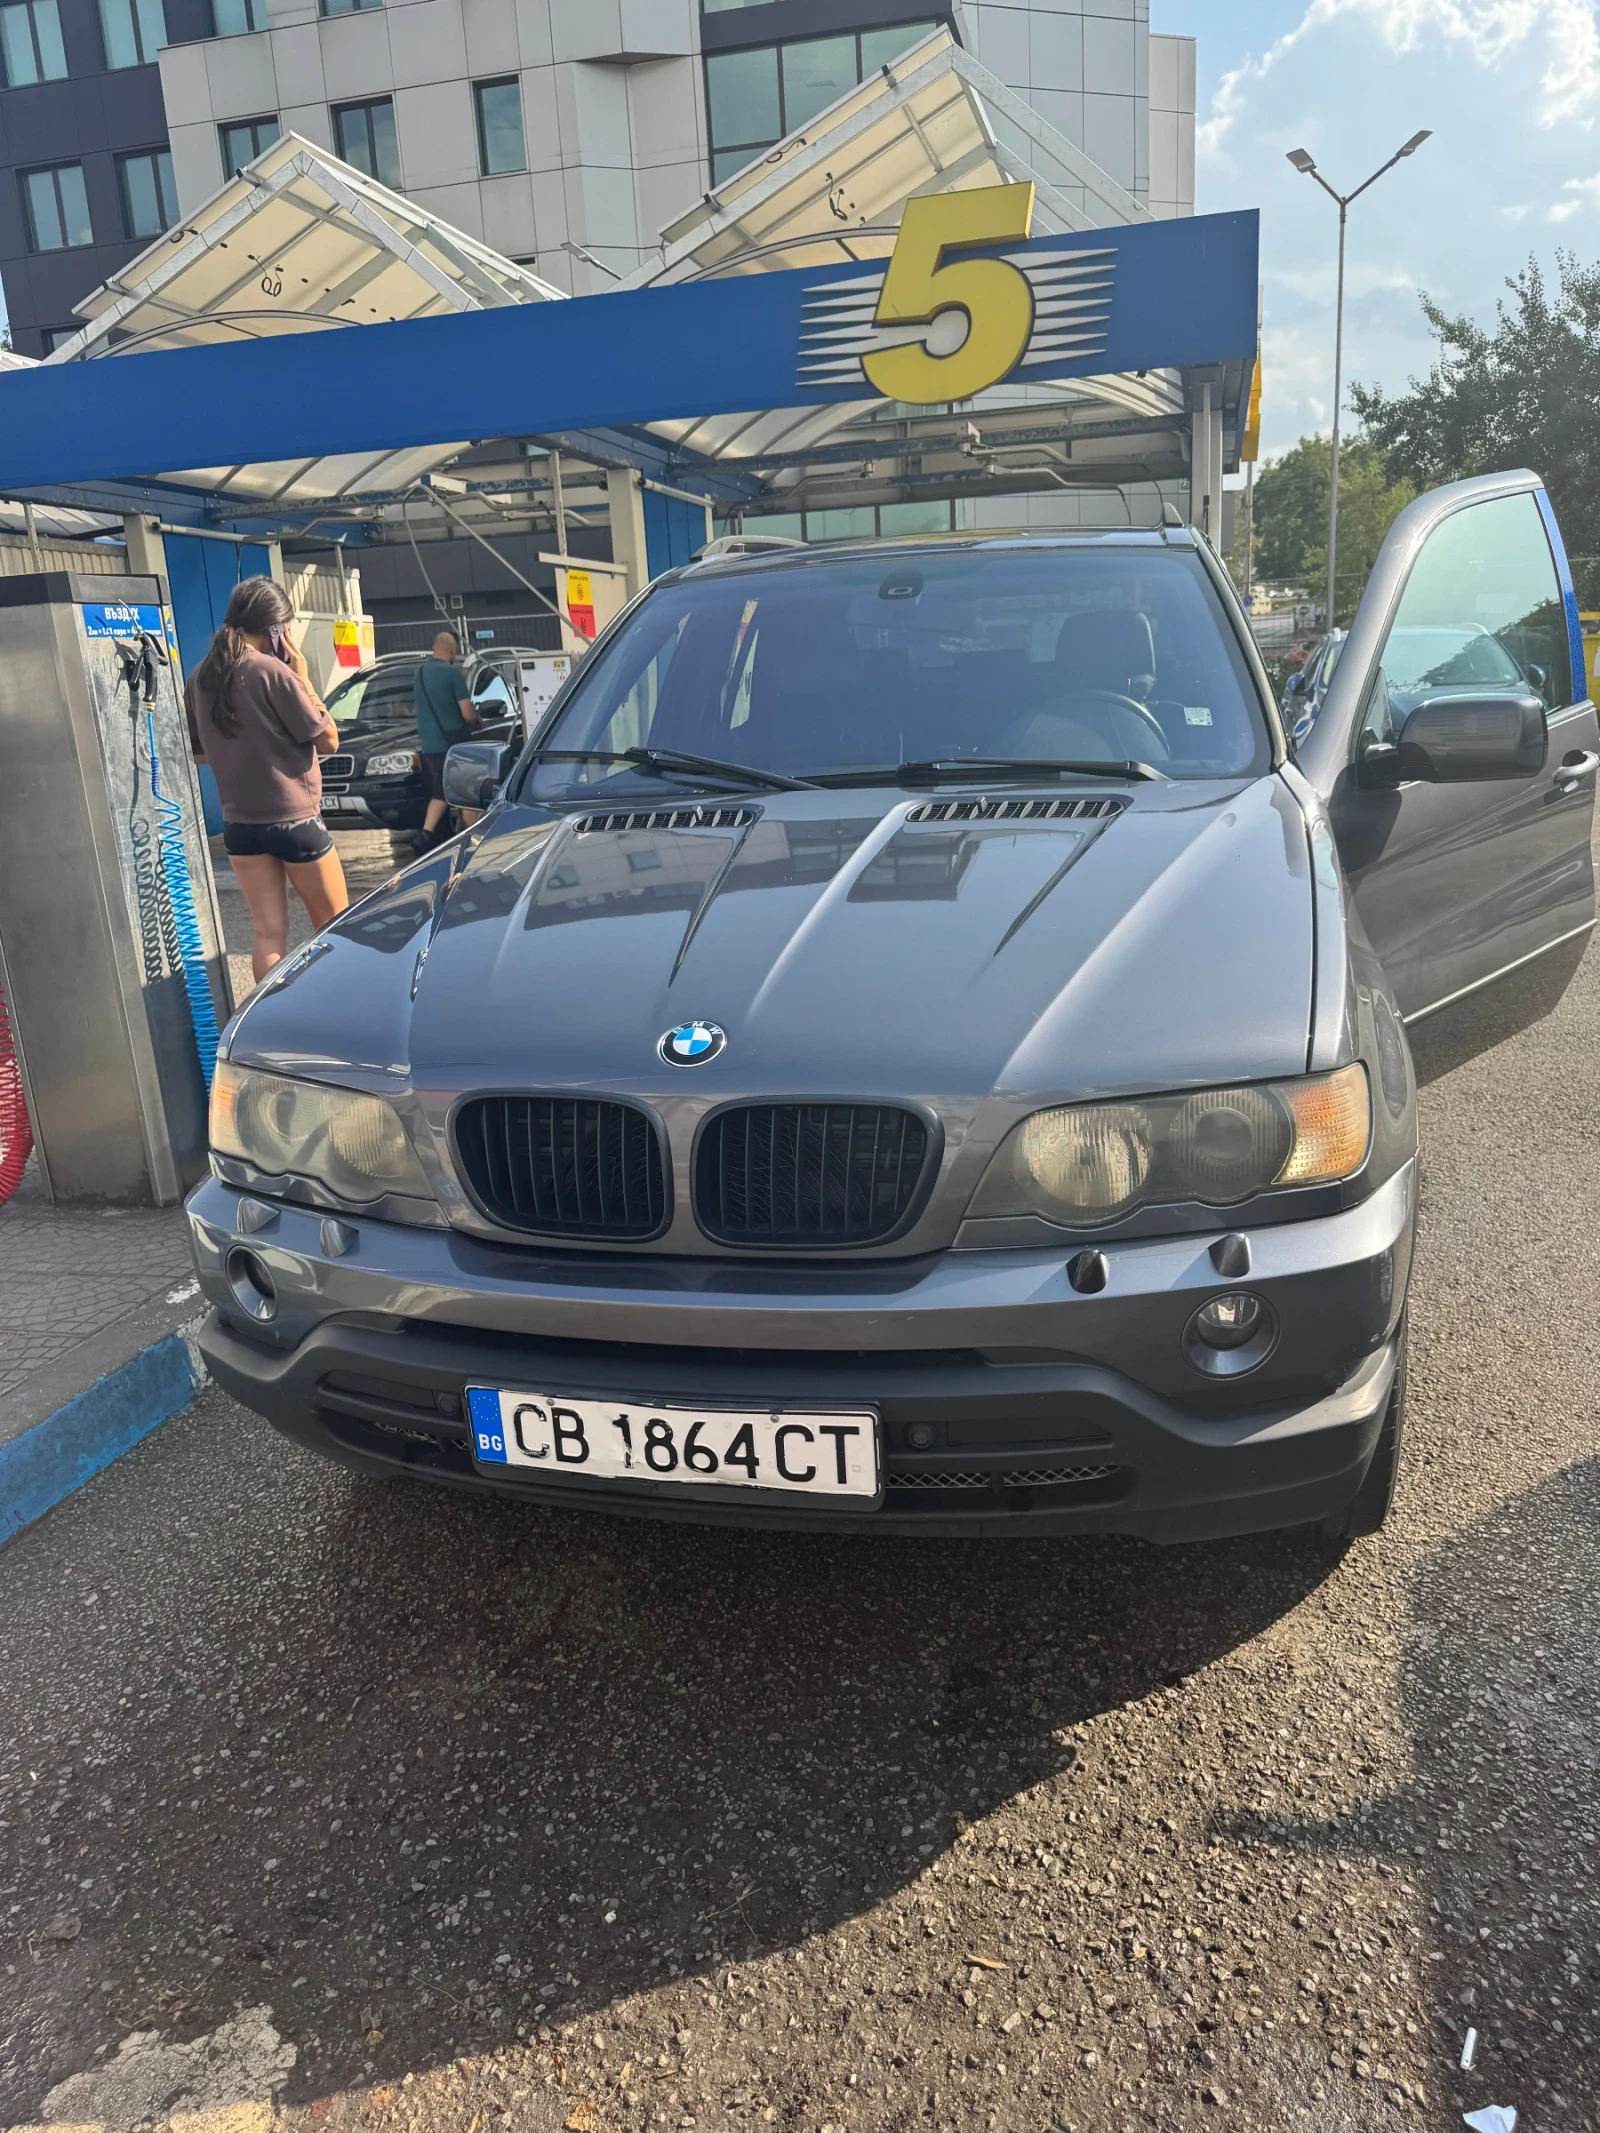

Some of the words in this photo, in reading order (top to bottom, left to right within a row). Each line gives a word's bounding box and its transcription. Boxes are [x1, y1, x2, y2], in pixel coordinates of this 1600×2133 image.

[861, 180, 1036, 405] 5
[672, 1021, 722, 1035] BMW
[478, 1433, 503, 1451] BG
